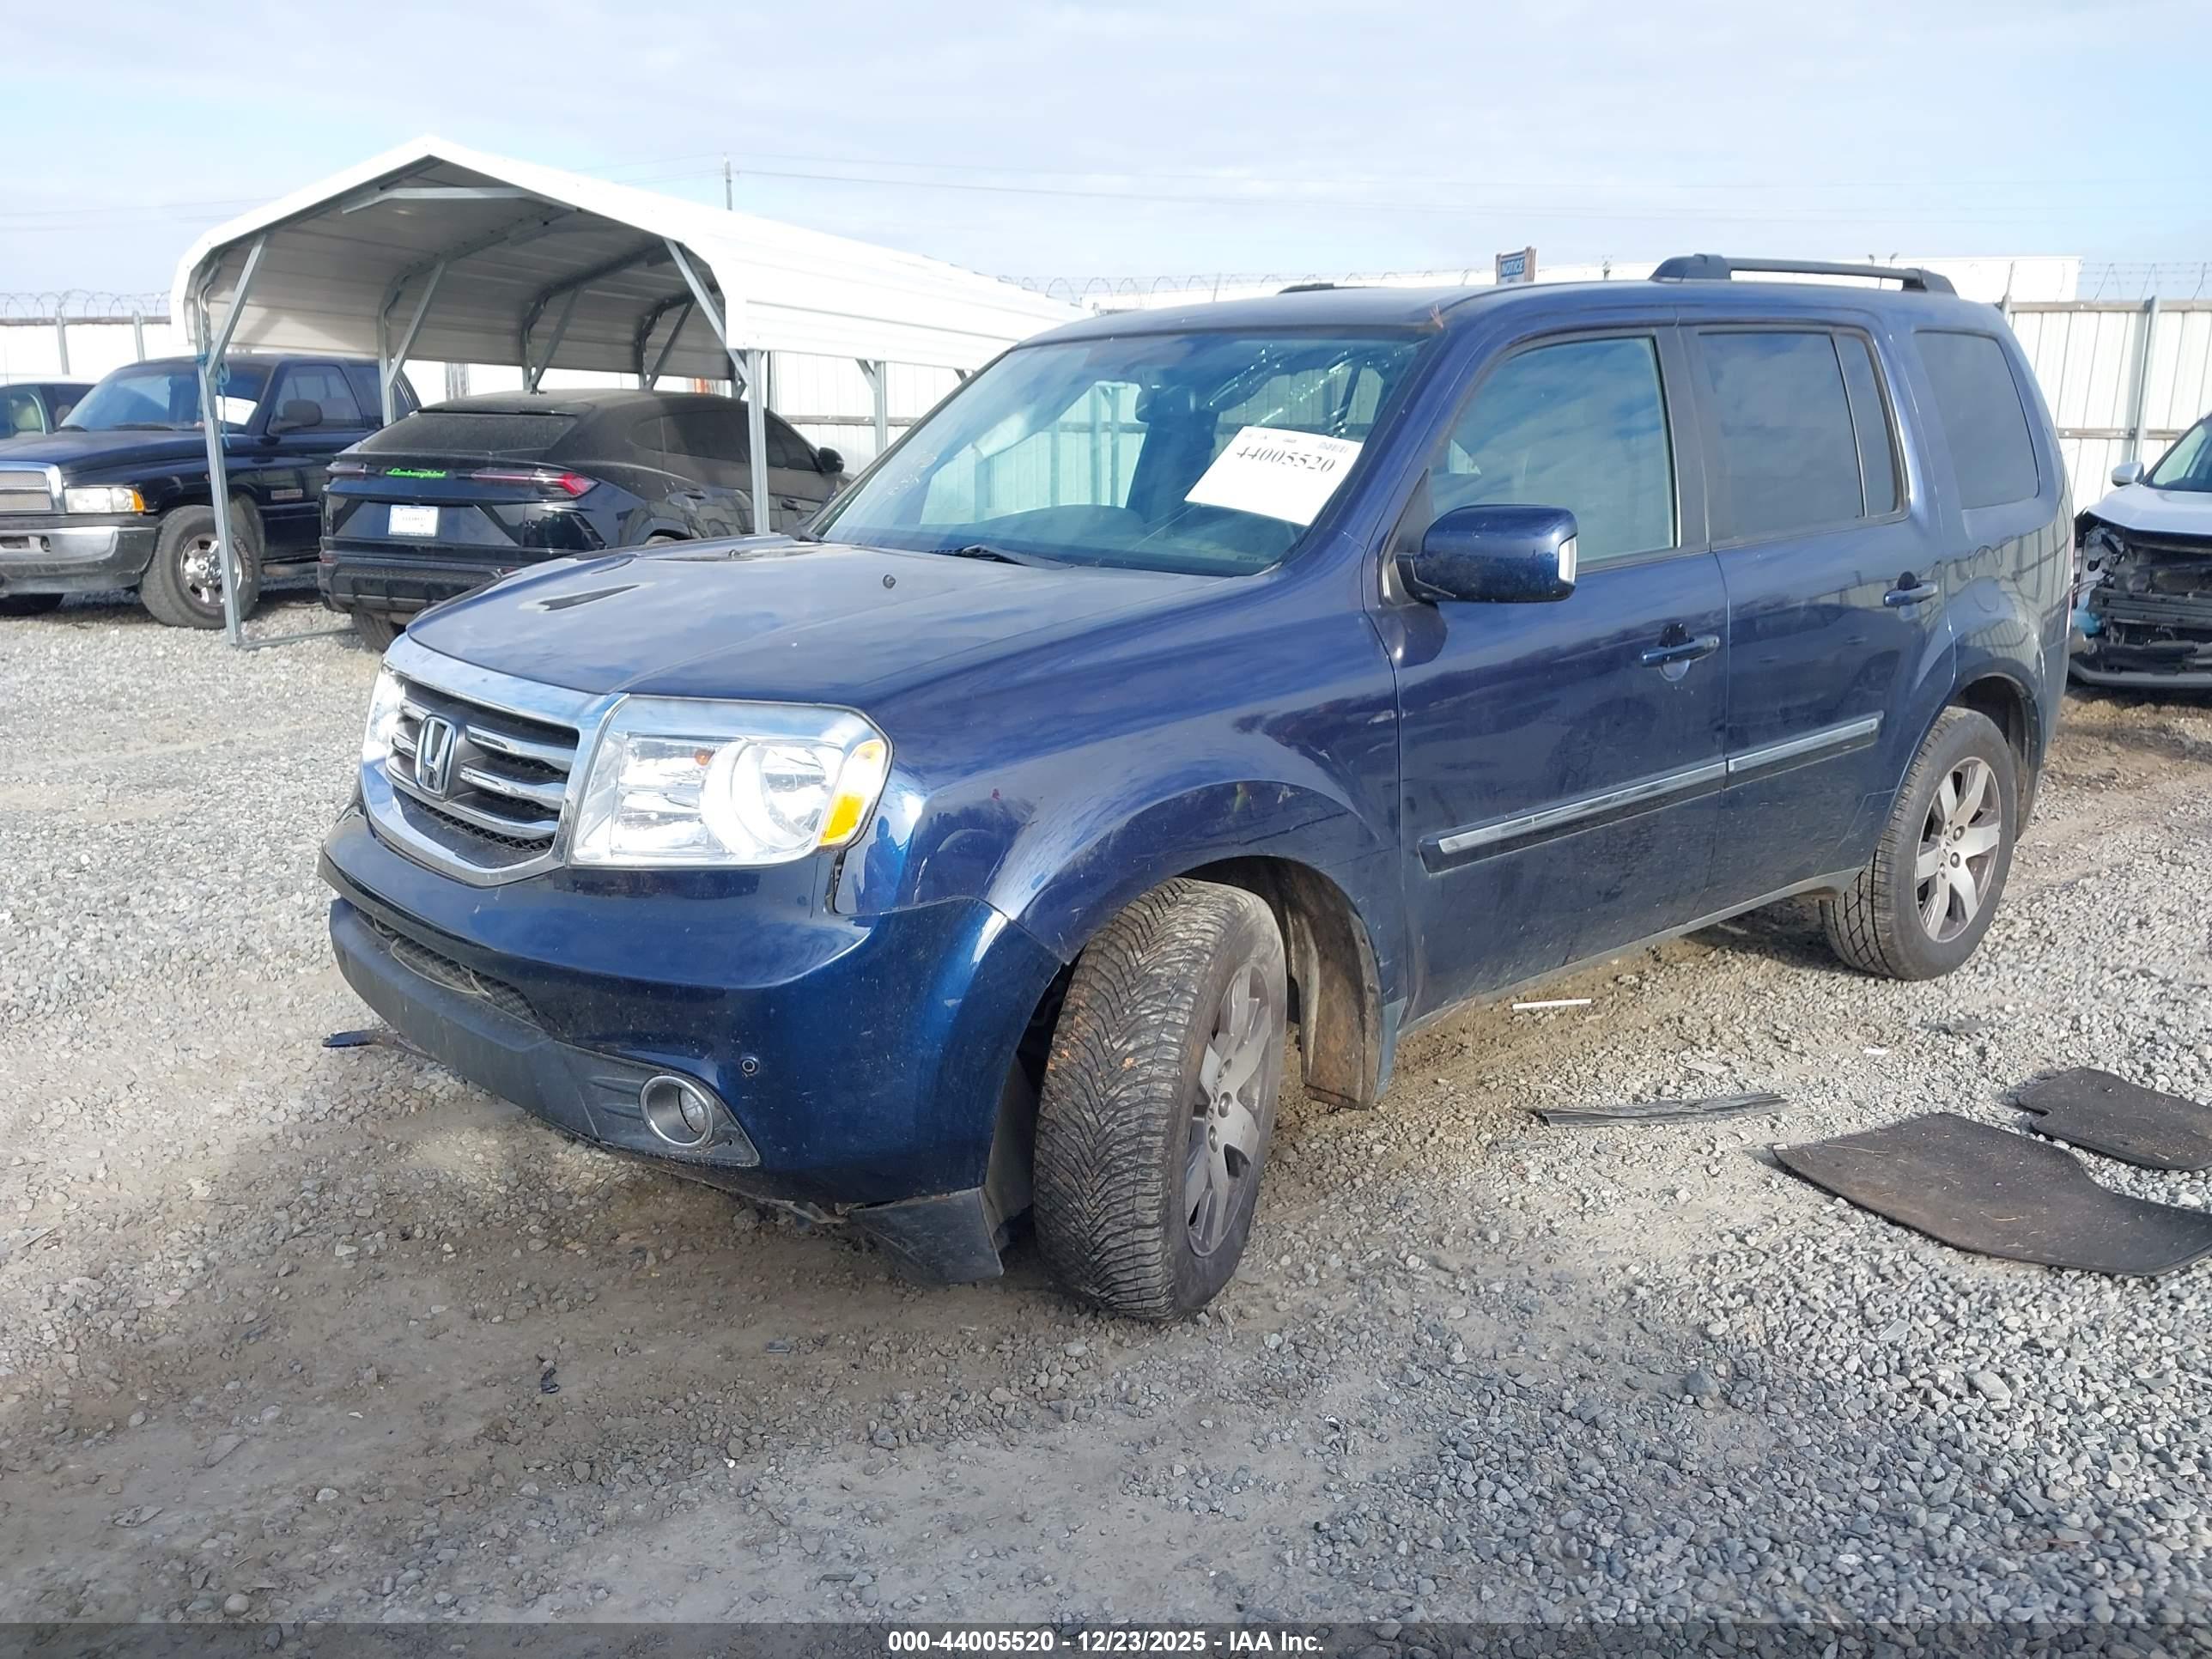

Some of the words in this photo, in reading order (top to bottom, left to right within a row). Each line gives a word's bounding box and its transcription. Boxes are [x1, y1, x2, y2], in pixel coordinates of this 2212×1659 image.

[1502, 259, 1524, 275] NOTICE
[1237, 446, 1336, 471] 44005520
[386, 468, 447, 478] Lamborghini
